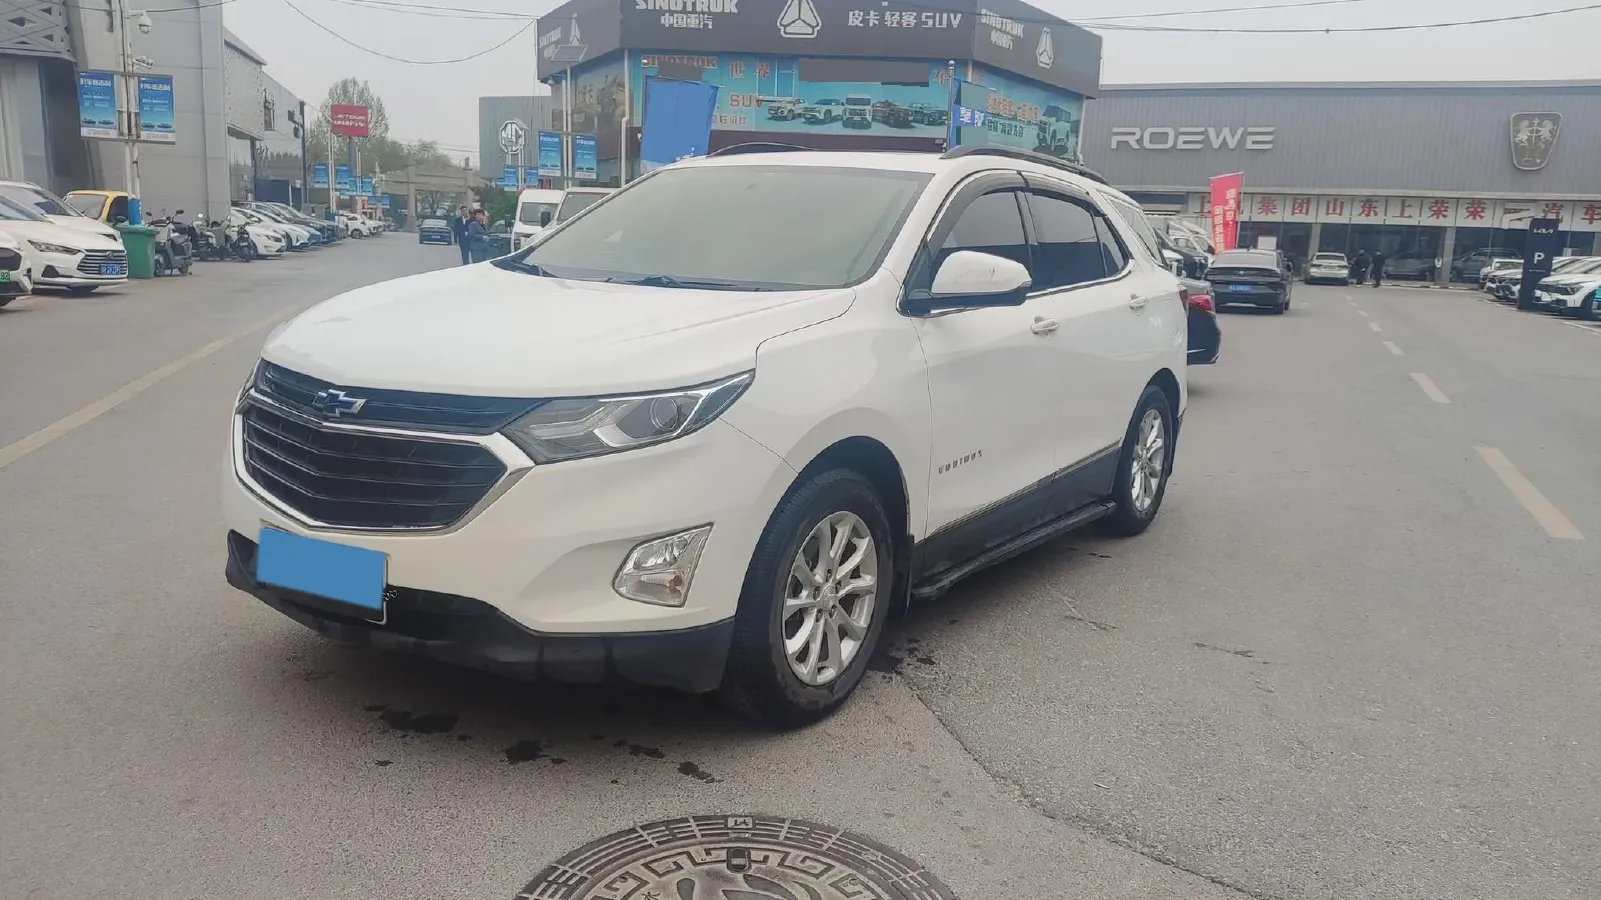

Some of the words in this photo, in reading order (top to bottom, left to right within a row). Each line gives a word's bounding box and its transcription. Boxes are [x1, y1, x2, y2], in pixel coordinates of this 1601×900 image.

[660, 12, 714, 29] 中国重汽
[847, 9, 881, 28] 皮卡
[884, 10, 918, 29] 轻客
[920, 12, 962, 29] SUV
[1110, 126, 1276, 151] ROEWE
[1533, 252, 1545, 264] P
